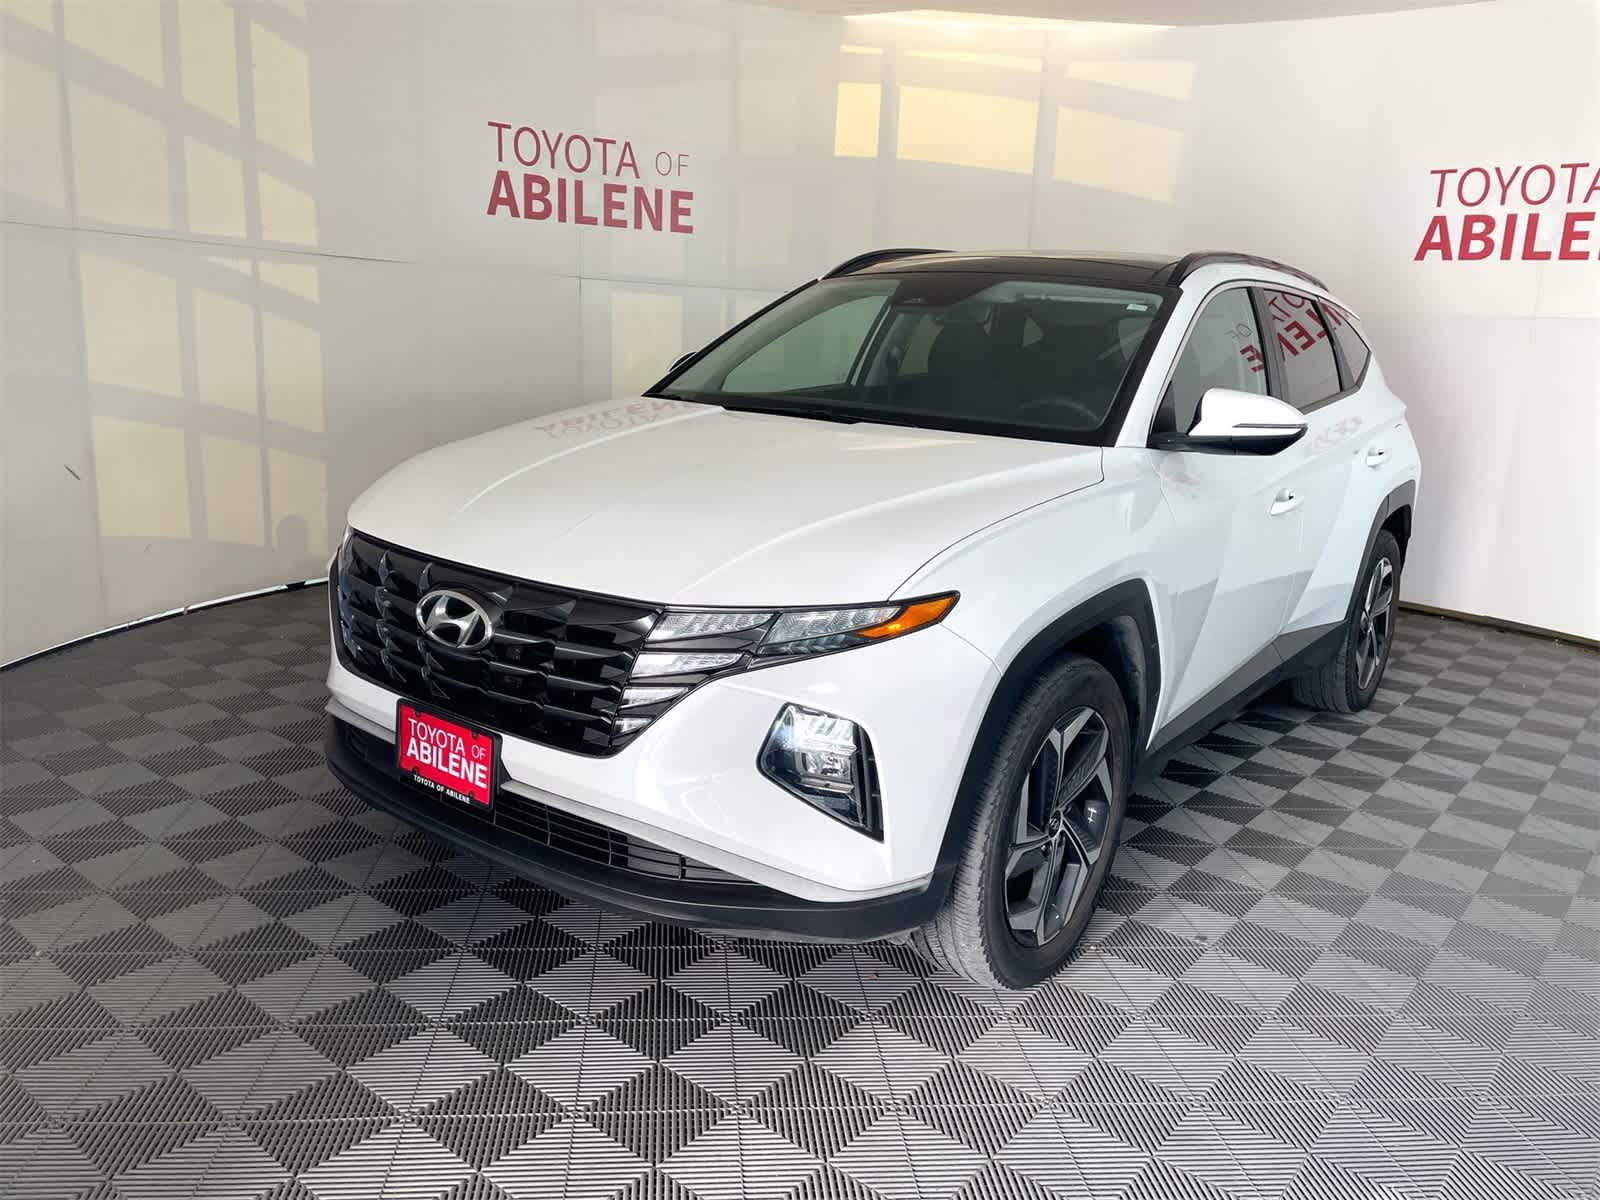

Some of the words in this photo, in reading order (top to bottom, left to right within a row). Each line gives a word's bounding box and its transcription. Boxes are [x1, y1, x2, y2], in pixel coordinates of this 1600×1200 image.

[487, 121, 641, 180] TOYOTA
[655, 151, 690, 177] OF
[486, 169, 694, 234] ABILENE
[1413, 211, 1600, 261] ABILE
[406, 737, 488, 789] ABILENE
[408, 717, 466, 757] TOYOTA
[471, 744, 487, 759] OF
[413, 774, 435, 789] TOYOTA
[436, 784, 445, 793] OF
[445, 788, 471, 804] ABILENE
